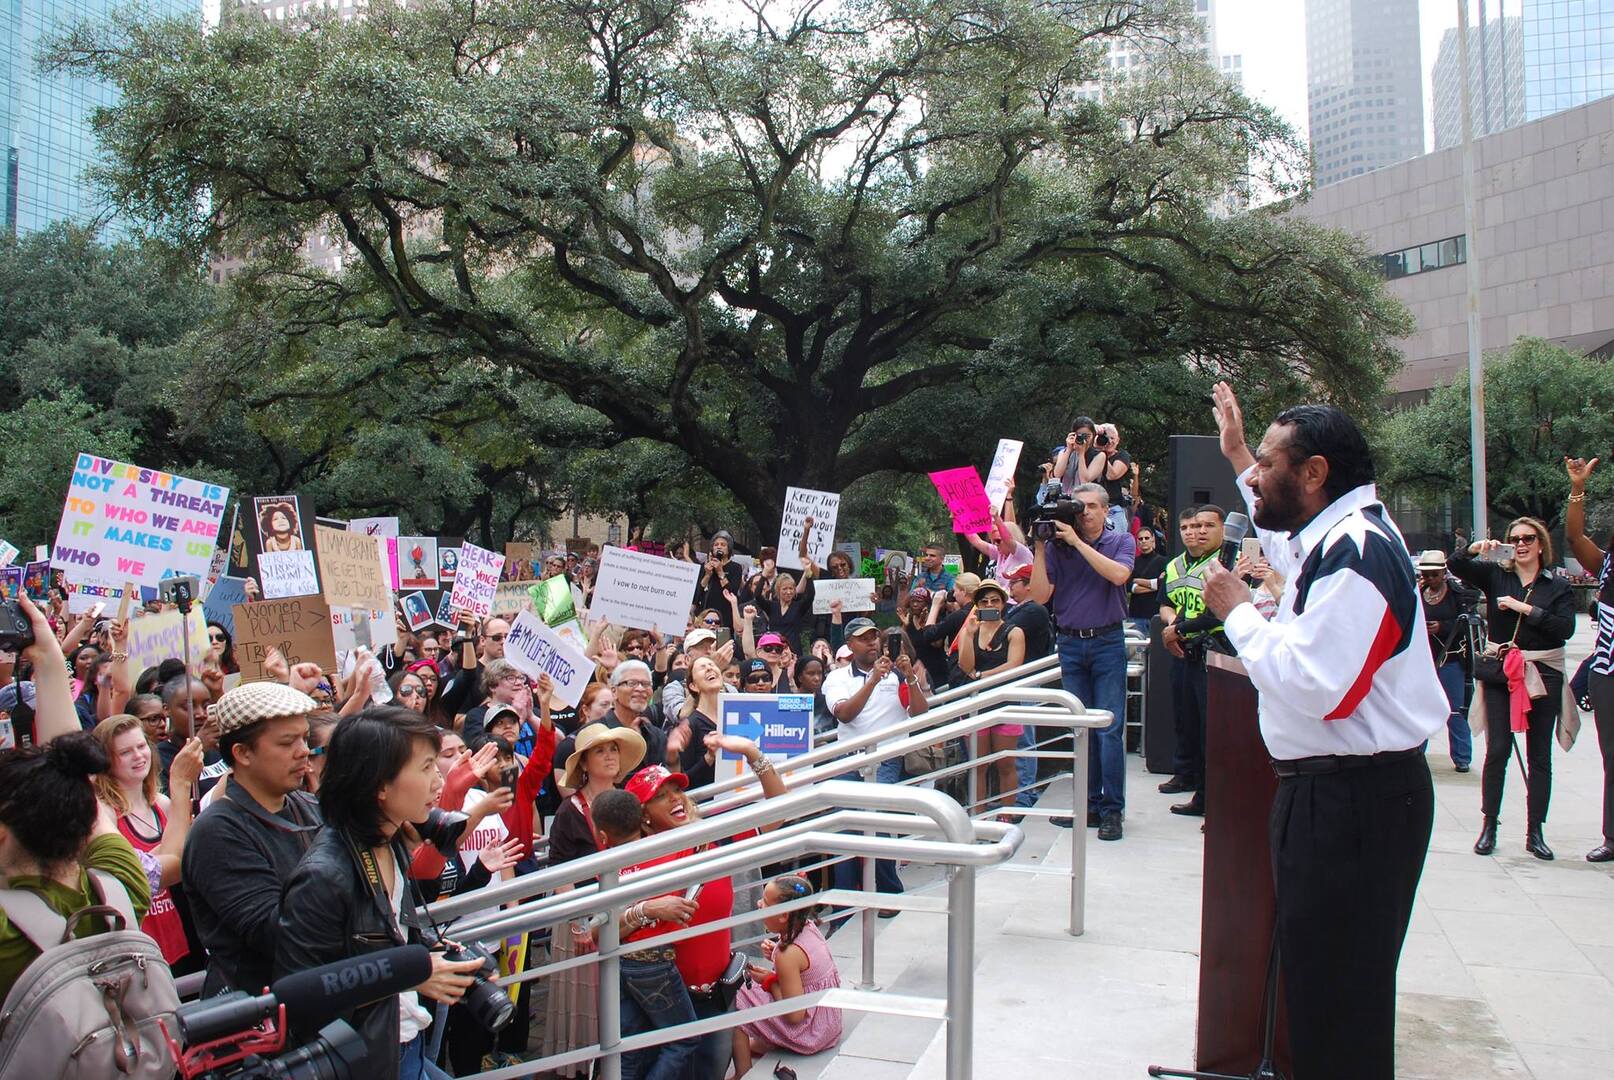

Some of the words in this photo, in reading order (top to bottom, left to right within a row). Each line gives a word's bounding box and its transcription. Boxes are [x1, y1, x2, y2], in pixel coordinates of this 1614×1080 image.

[77, 455, 184, 490] DIVERSITY
[202, 485, 222, 500] IS
[72, 472, 115, 493] NOT
[123, 483, 137, 498] A
[150, 488, 224, 518] THREAT
[792, 490, 819, 504] KEEP
[68, 497, 96, 515] TO
[104, 503, 148, 525] WHO
[152, 513, 180, 531] WE
[180, 519, 219, 537] ARE
[784, 513, 818, 529] RELIN
[819, 522, 834, 532] OUT
[811, 506, 831, 519] AND
[72, 521, 94, 536] IT
[104, 526, 173, 551] MAKES
[185, 542, 213, 558] US
[789, 538, 825, 556] "PSY"
[56, 546, 100, 566] WHO
[117, 557, 145, 576] WE
[461, 542, 496, 568] HEAR
[342, 562, 357, 577] GET
[358, 565, 376, 581] THE
[461, 560, 478, 571] OUR
[456, 572, 496, 599] RESPECT
[475, 570, 498, 587] VOICE
[68, 583, 140, 600] INERSECIOAL
[333, 581, 350, 597] JOB
[352, 581, 384, 601] DONE
[468, 591, 479, 600] ALL
[617, 580, 629, 588] vow
[639, 584, 650, 592] not
[650, 586, 665, 595] burn
[665, 590, 678, 598] out.
[241, 600, 301, 619] Women
[452, 591, 489, 615] BODIES
[1174, 591, 1200, 611] OCE
[250, 611, 304, 637] POWER
[332, 609, 383, 625] SILED
[507, 622, 576, 686] #MYLIFEMATTERS
[253, 656, 301, 679] TOR
[764, 724, 806, 740] Hillary
[320, 958, 393, 995] RØDE
